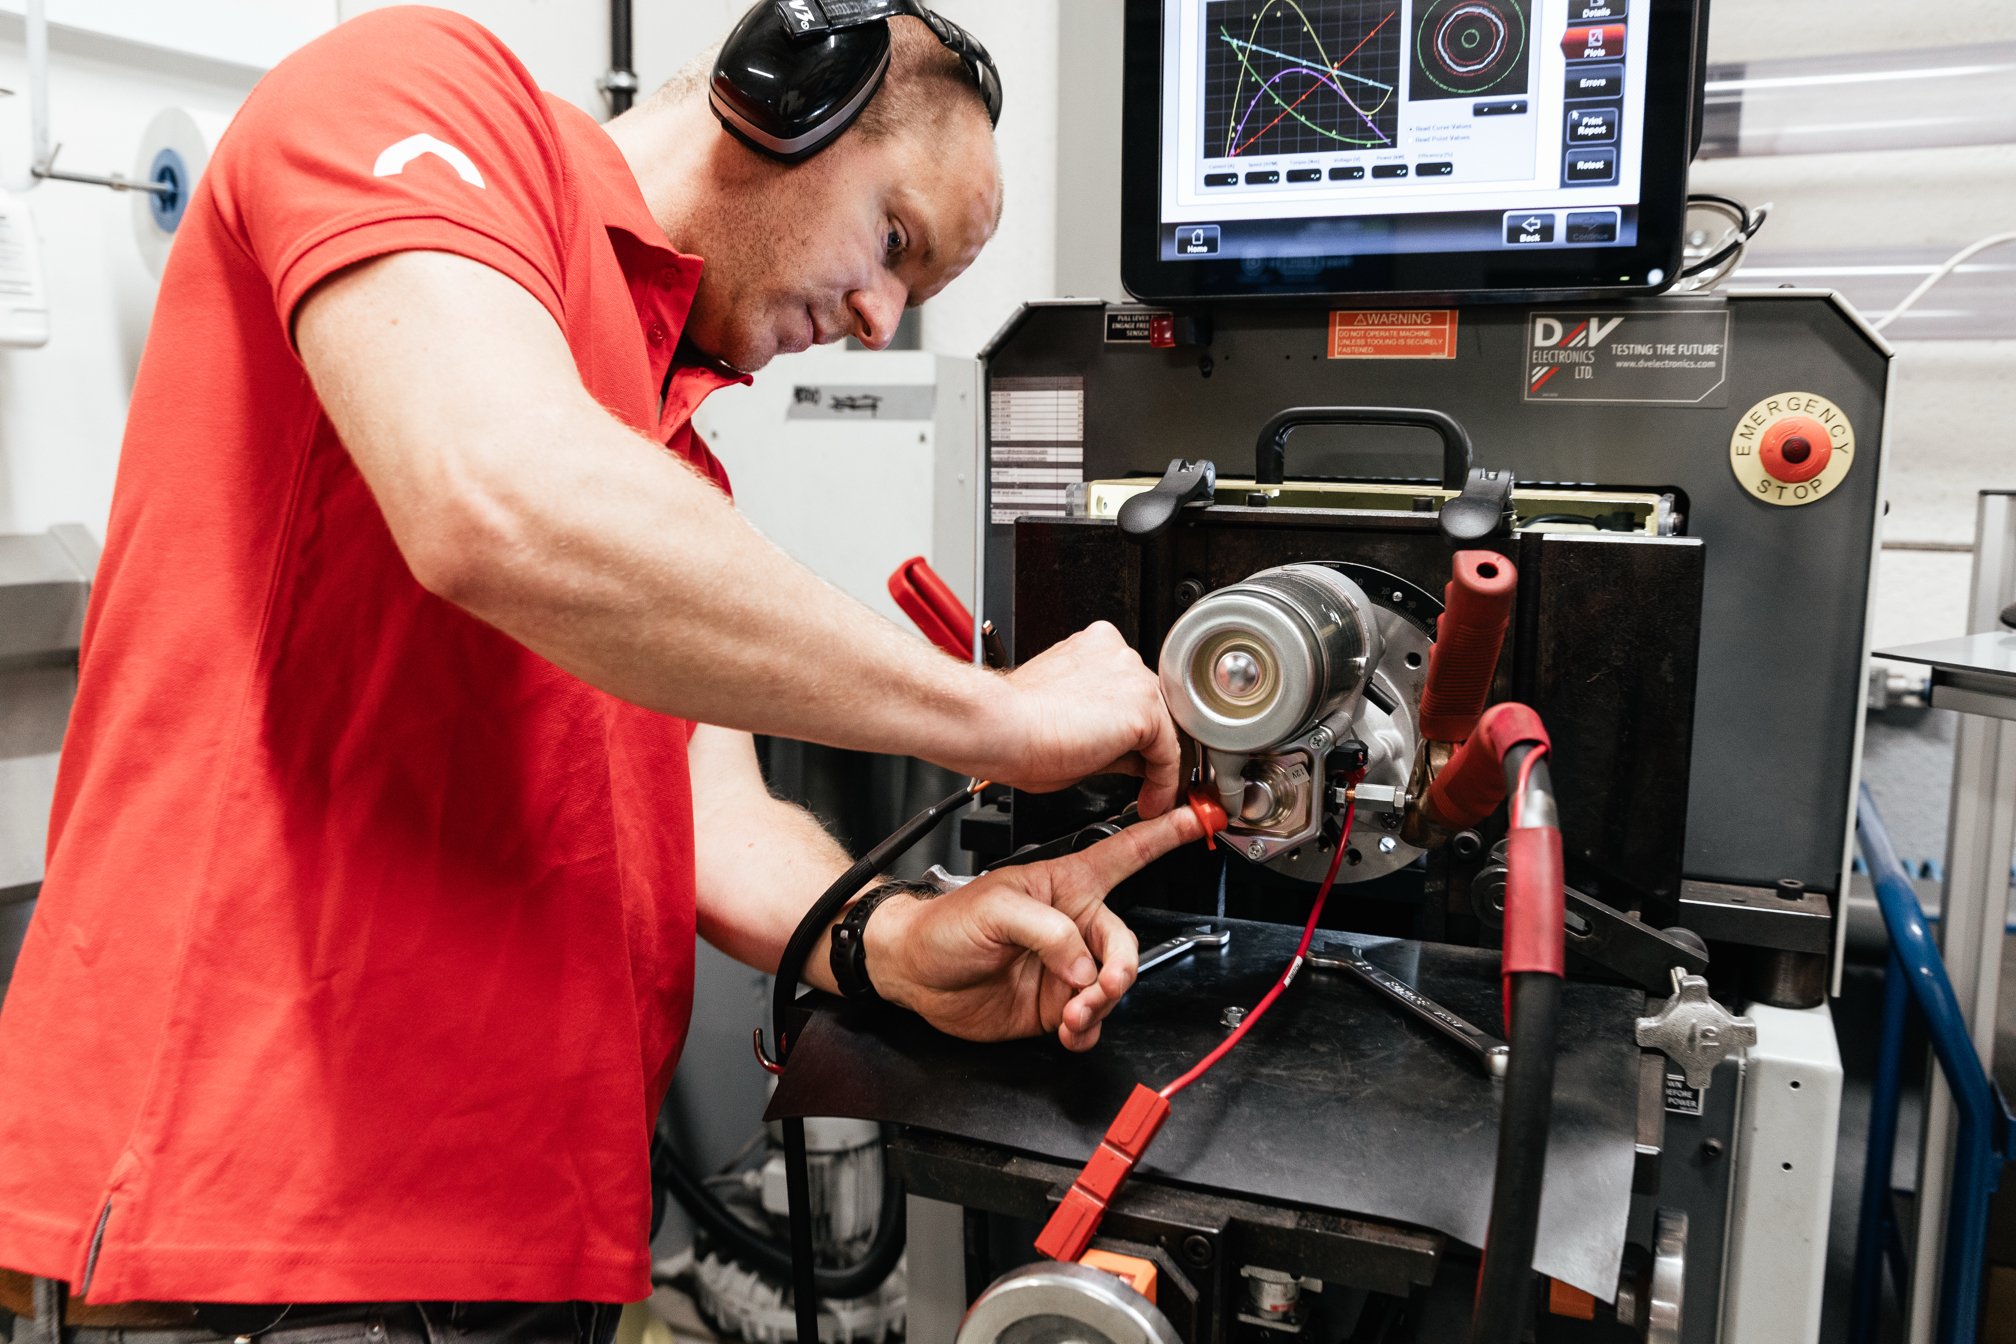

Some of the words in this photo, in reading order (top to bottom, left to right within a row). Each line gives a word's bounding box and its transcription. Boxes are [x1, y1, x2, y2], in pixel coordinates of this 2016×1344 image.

[1582, 7, 1611, 18] Details
[1584, 48, 1606, 58] Plots
[1580, 78, 1606, 88] Errors
[1582, 116, 1603, 126] Print
[1577, 125, 1607, 136] Report
[1520, 233, 1541, 242] Back
[1573, 232, 1608, 241] Continue
[1187, 245, 1208, 253] Home
[1367, 313, 1432, 325] WARNING
[1611, 344, 1653, 355] TESTING
[1656, 344, 1676, 355] THE
[1532, 350, 1595, 364] ELECTRONICS
[1615, 359, 1717, 369] www.dvelectronics.com
[1574, 366, 1594, 379] LTD.
[1736, 396, 1849, 456] EMERGENCY
[1757, 478, 1823, 500] STOP
[1668, 1097, 1697, 1107] POWER
